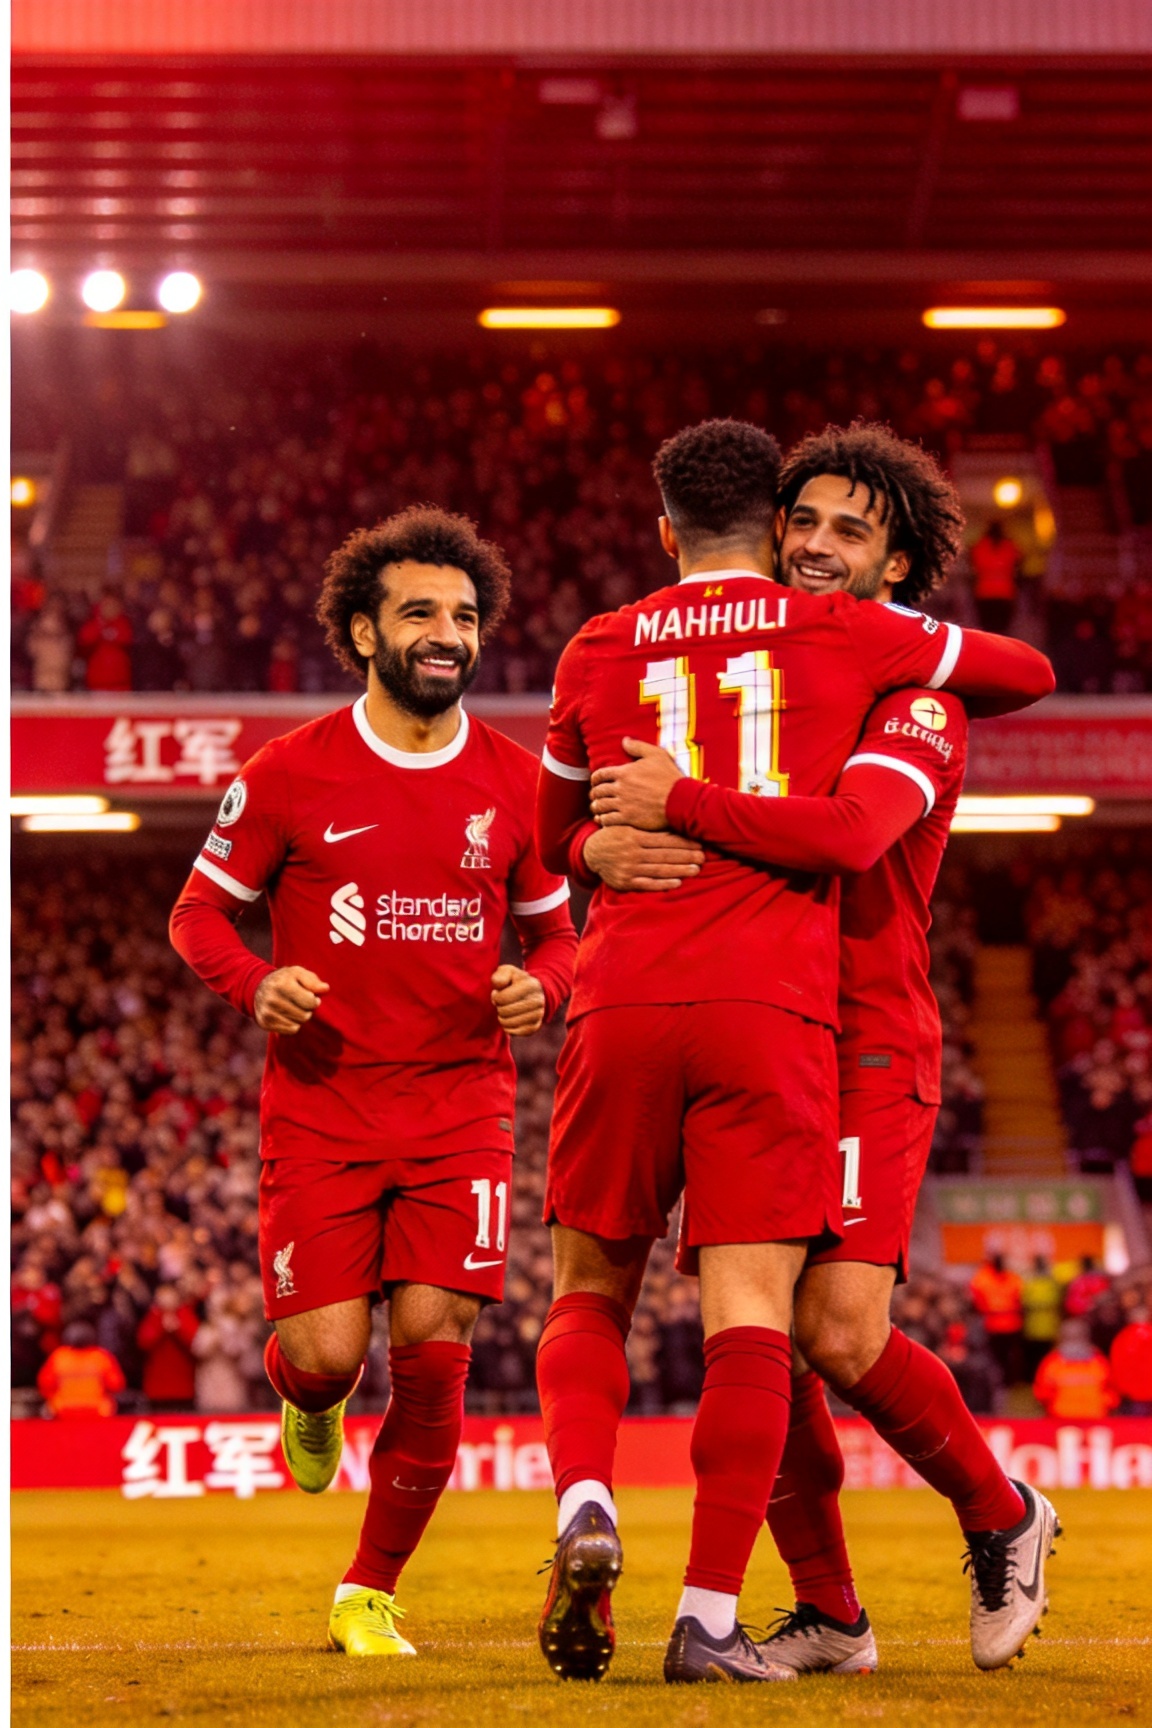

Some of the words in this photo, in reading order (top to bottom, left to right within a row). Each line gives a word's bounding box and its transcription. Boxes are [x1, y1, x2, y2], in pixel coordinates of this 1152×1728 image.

[104, 718, 243, 785] 红军
[638, 650, 790, 797] 11
[470, 1178, 507, 1252] 11
[121, 1421, 283, 1498] 红军
